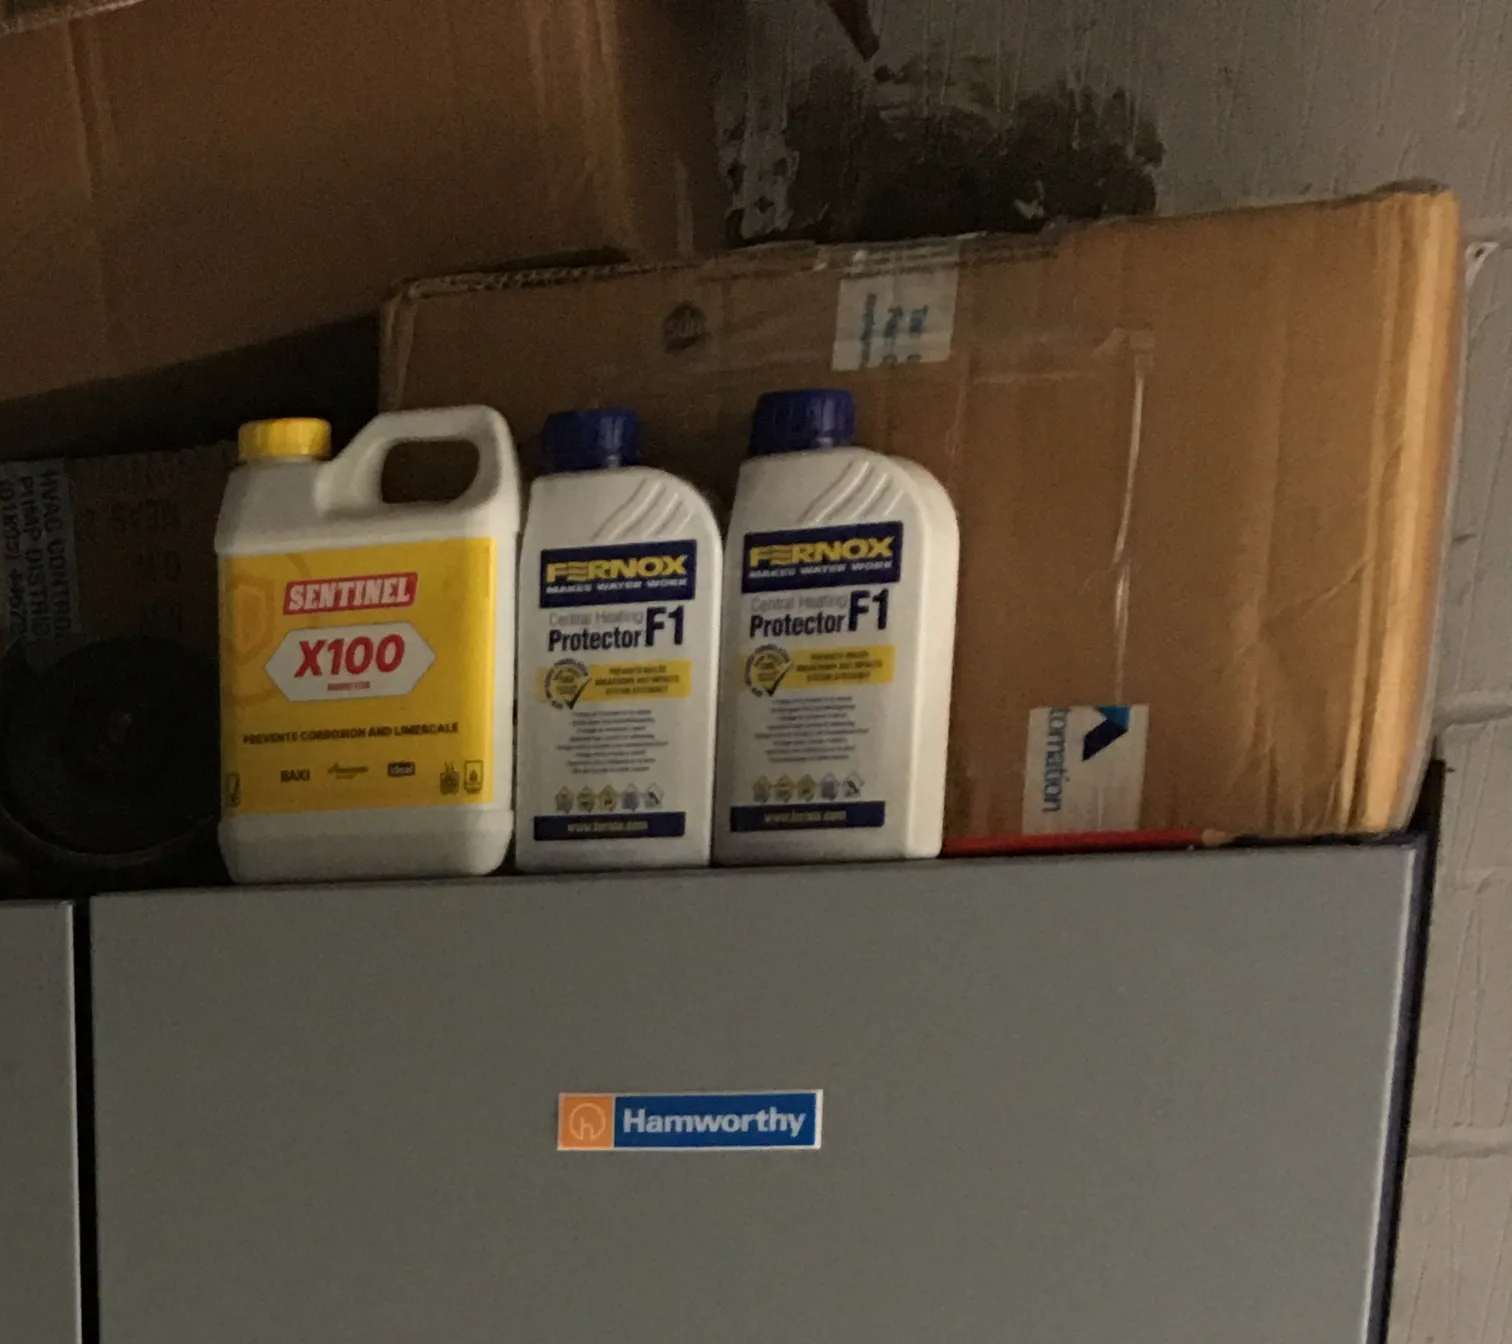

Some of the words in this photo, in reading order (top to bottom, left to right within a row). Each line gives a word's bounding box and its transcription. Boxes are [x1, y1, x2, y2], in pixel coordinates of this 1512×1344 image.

[749, 536, 896, 568] FERNOX
[546, 554, 688, 583] FERNOX
[287, 575, 410, 611] SENTINEL
[751, 594, 795, 612] Central
[798, 593, 848, 610] Heating
[548, 626, 642, 652] Protector
[645, 604, 684, 647] F1
[549, 611, 592, 625] Central
[595, 609, 643, 624] Heating
[750, 611, 846, 639] Protector
[848, 588, 890, 632] F1
[293, 633, 406, 679] X100
[623, 1106, 807, 1138] Hamworthy
